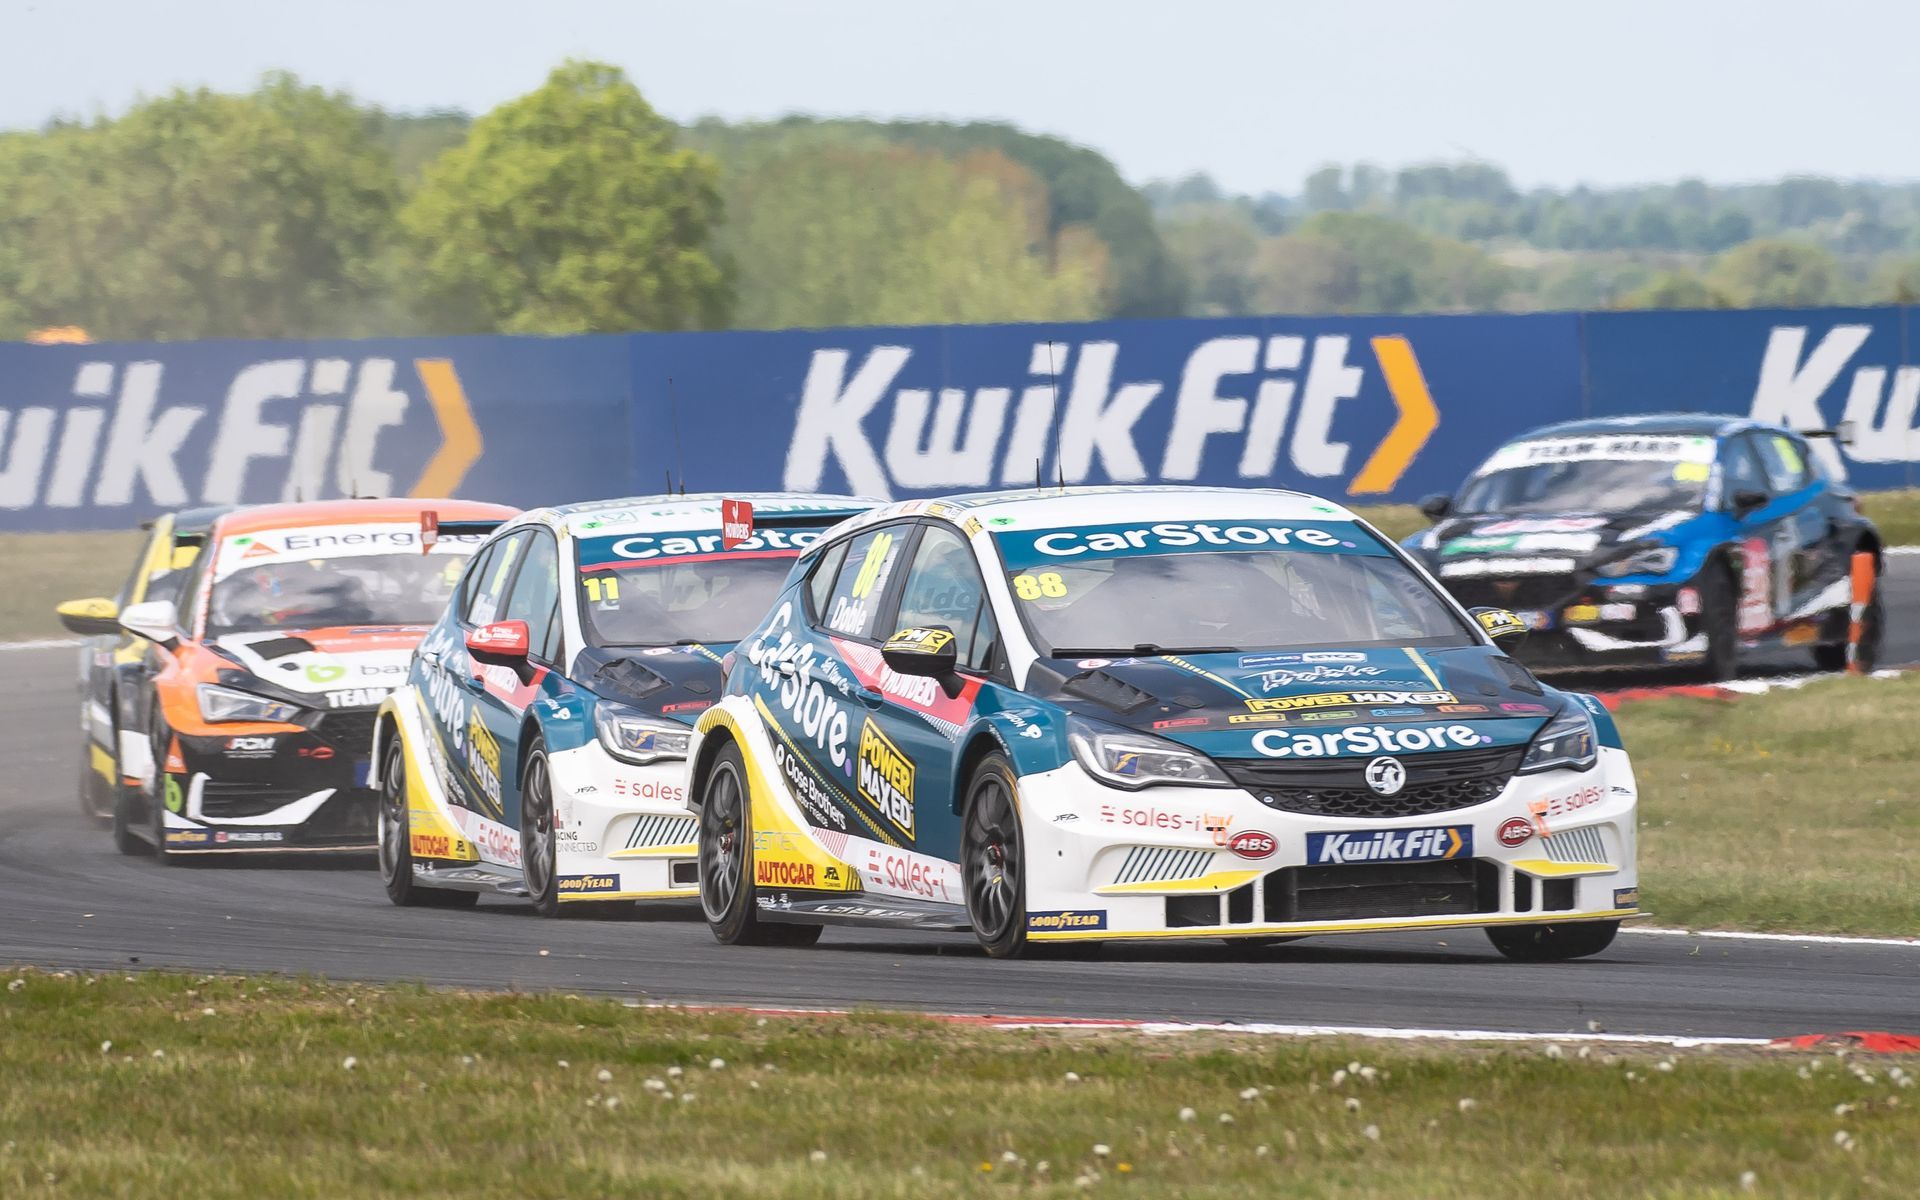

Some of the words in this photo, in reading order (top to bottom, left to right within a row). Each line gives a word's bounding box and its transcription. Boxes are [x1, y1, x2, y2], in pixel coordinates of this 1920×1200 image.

[284, 531, 481, 550] Energse
[724, 522, 750, 540] HOWDENS
[852, 532, 894, 599] 88
[583, 577, 619, 602] 11
[1013, 572, 1067, 600] 88
[830, 597, 868, 634] Doble
[892, 628, 948, 644] PMR
[1251, 693, 1352, 711] POWER
[1352, 690, 1452, 704] MAXED
[861, 729, 912, 794] POWER
[785, 754, 809, 793] Close
[809, 777, 846, 830] Brothers
[860, 758, 913, 829] MAXED
[1123, 807, 1200, 831] sales-i
[556, 831, 578, 841] ACING
[1501, 826, 1533, 840] ABS
[556, 842, 598, 852] ONNECTED
[1234, 838, 1274, 852] ABS
[559, 875, 614, 891] GOODYEAR
[757, 860, 816, 886] AUTOCAR
[886, 854, 950, 900] sales-i
[1028, 911, 1100, 929] GOODYEAR
